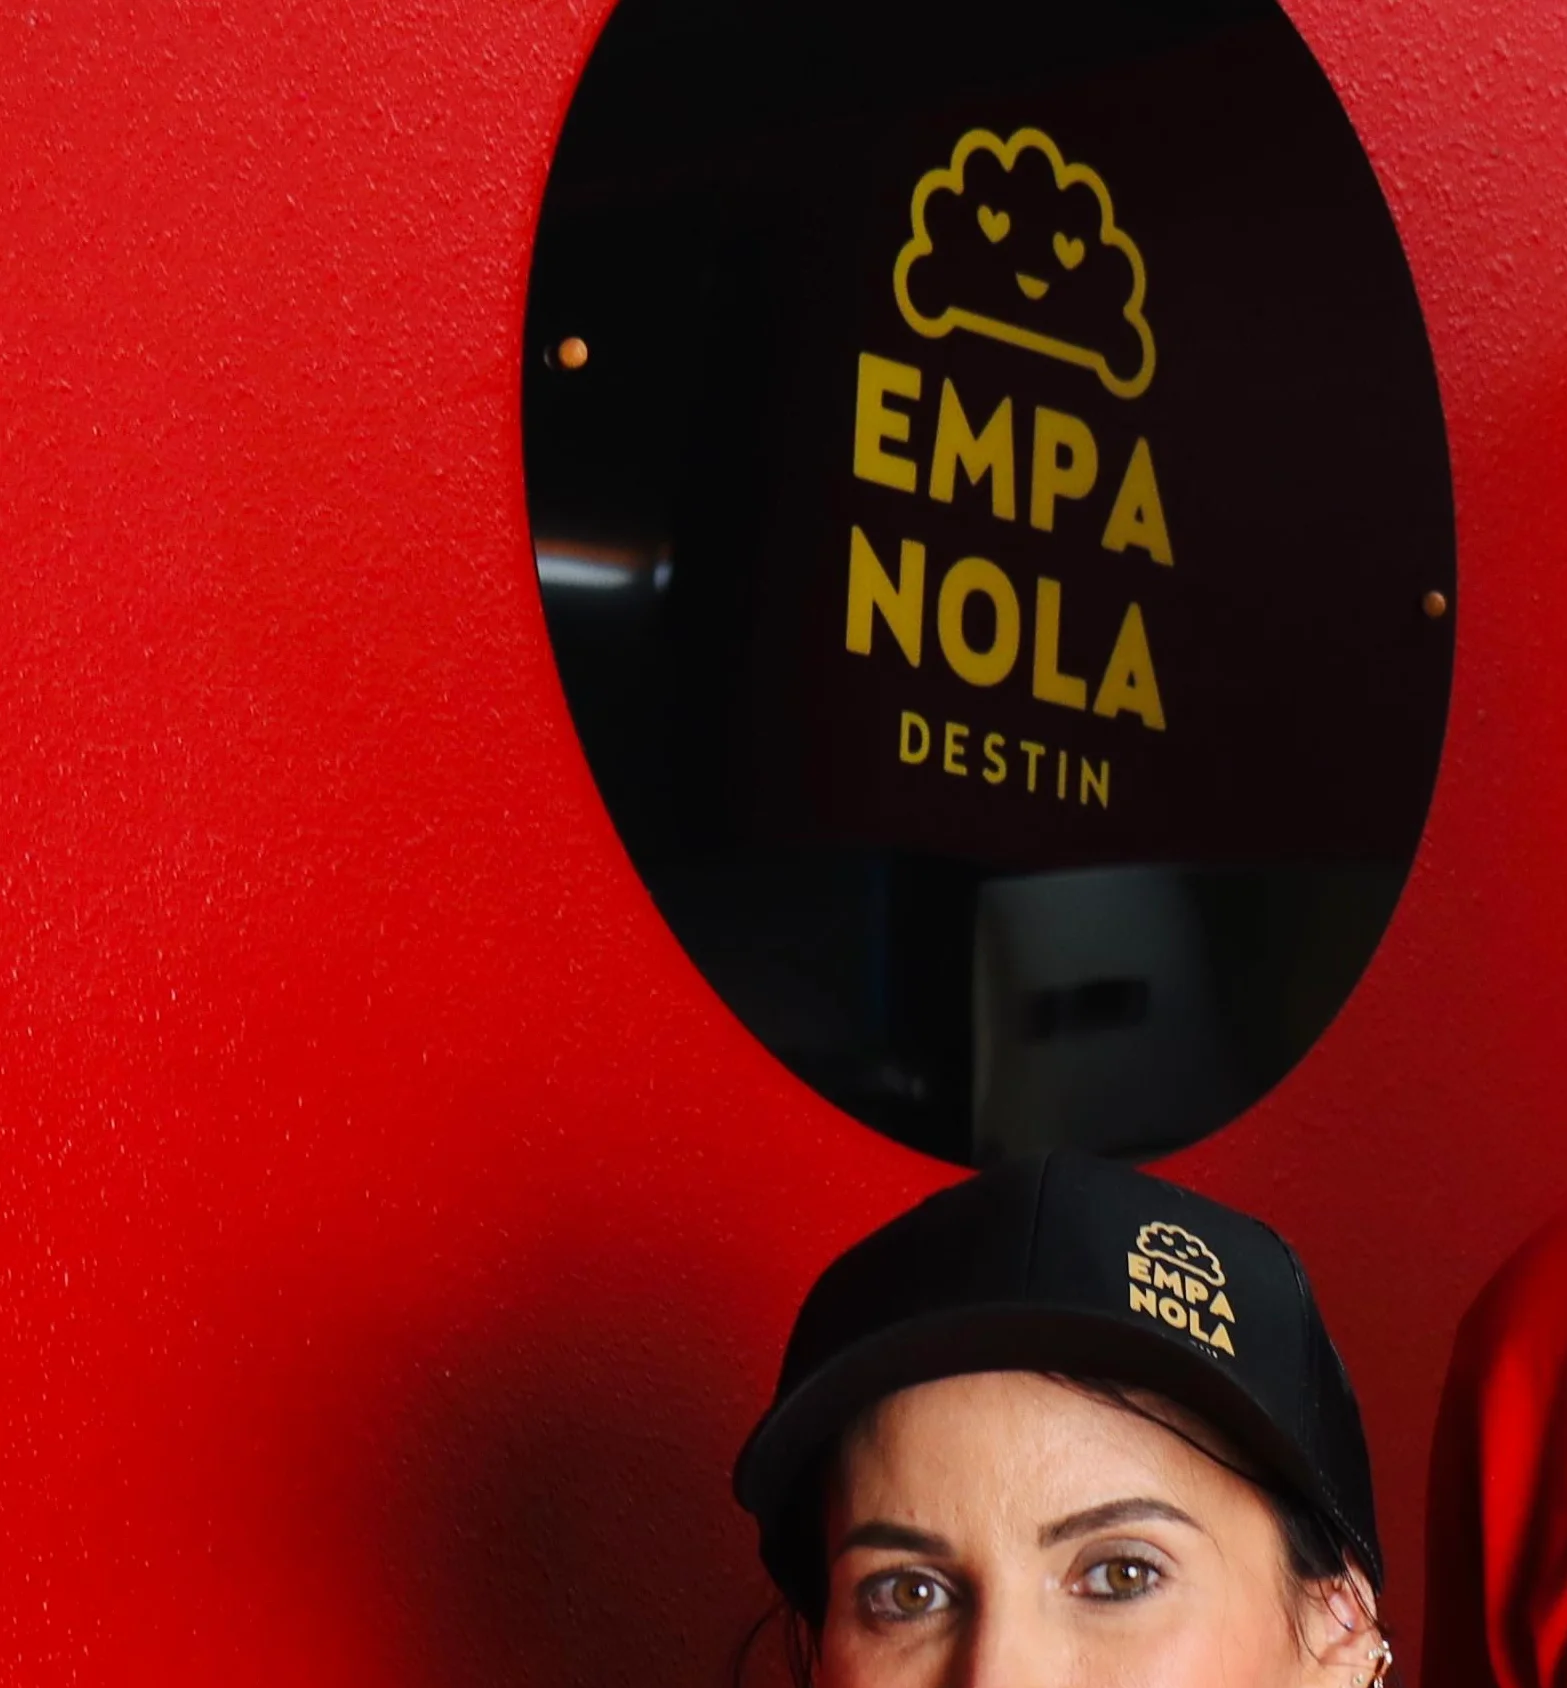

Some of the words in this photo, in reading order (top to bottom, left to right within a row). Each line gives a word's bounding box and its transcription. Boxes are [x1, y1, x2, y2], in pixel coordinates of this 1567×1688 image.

[853, 352, 1174, 567] EMPA
[845, 524, 1166, 731] NOLA
[899, 710, 1109, 809] DESTIN
[1127, 1251, 1236, 1324] EMPA
[1129, 1281, 1236, 1358] NOLA
